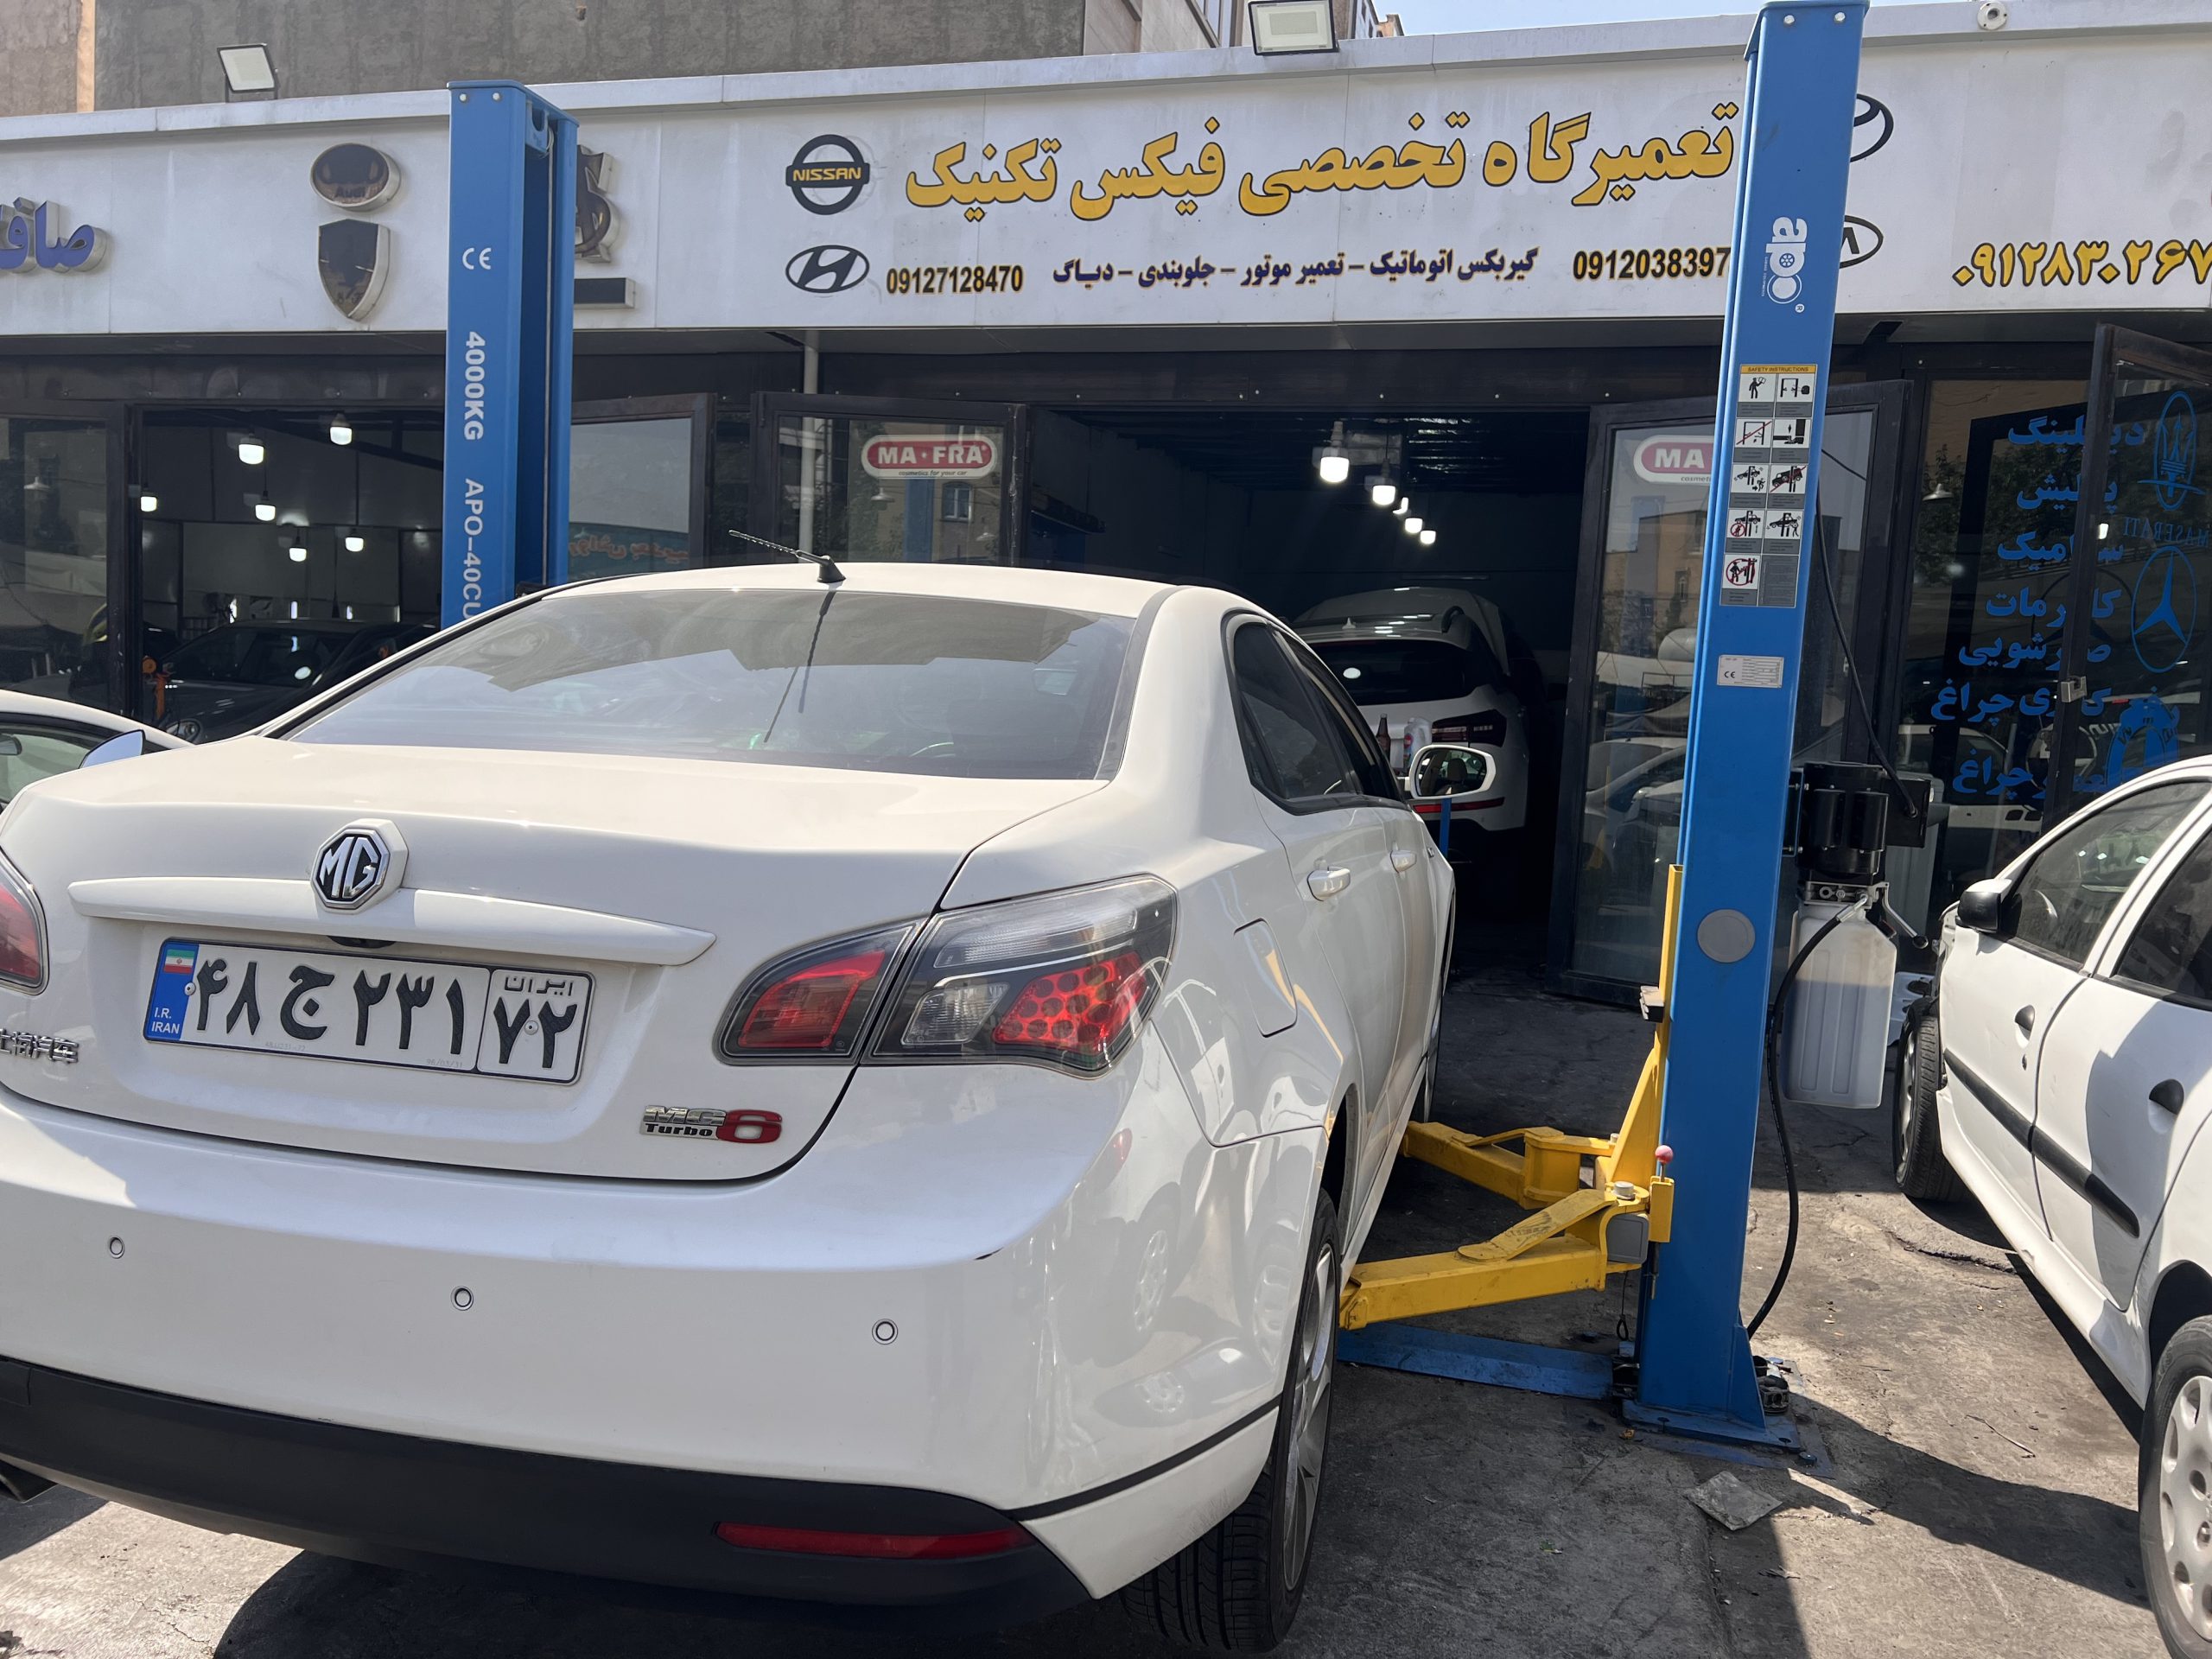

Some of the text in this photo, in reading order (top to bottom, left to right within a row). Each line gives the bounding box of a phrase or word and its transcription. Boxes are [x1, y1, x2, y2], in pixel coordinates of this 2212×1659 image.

[792, 167, 862, 182] NISSAN
[906, 101, 1738, 222] تعمیرگاه تخصصی فیکس تکنیک
[886, 264, 1023, 295] 09127128470
[1137, 255, 1216, 288] جلوبندی
[1240, 254, 1291, 286] موتور
[1296, 251, 1345, 286] تعمیر
[1370, 249, 1453, 283] اتوماتیک
[1457, 246, 1540, 281] گیربکس
[1572, 246, 1732, 280] 0912038397
[463, 331, 486, 441] 4000KG
[1930, 678, 2015, 726] چراغ
[1952, 748, 2034, 800] چراغ
[319, 836, 379, 899] MG
[504, 976, 574, 996] ایران
[151, 1020, 181, 1034] IRAN
[154, 1007, 172, 1020] I.R.
[493, 996, 578, 1069] ۷۲
[645, 1123, 713, 1137] Turbo
